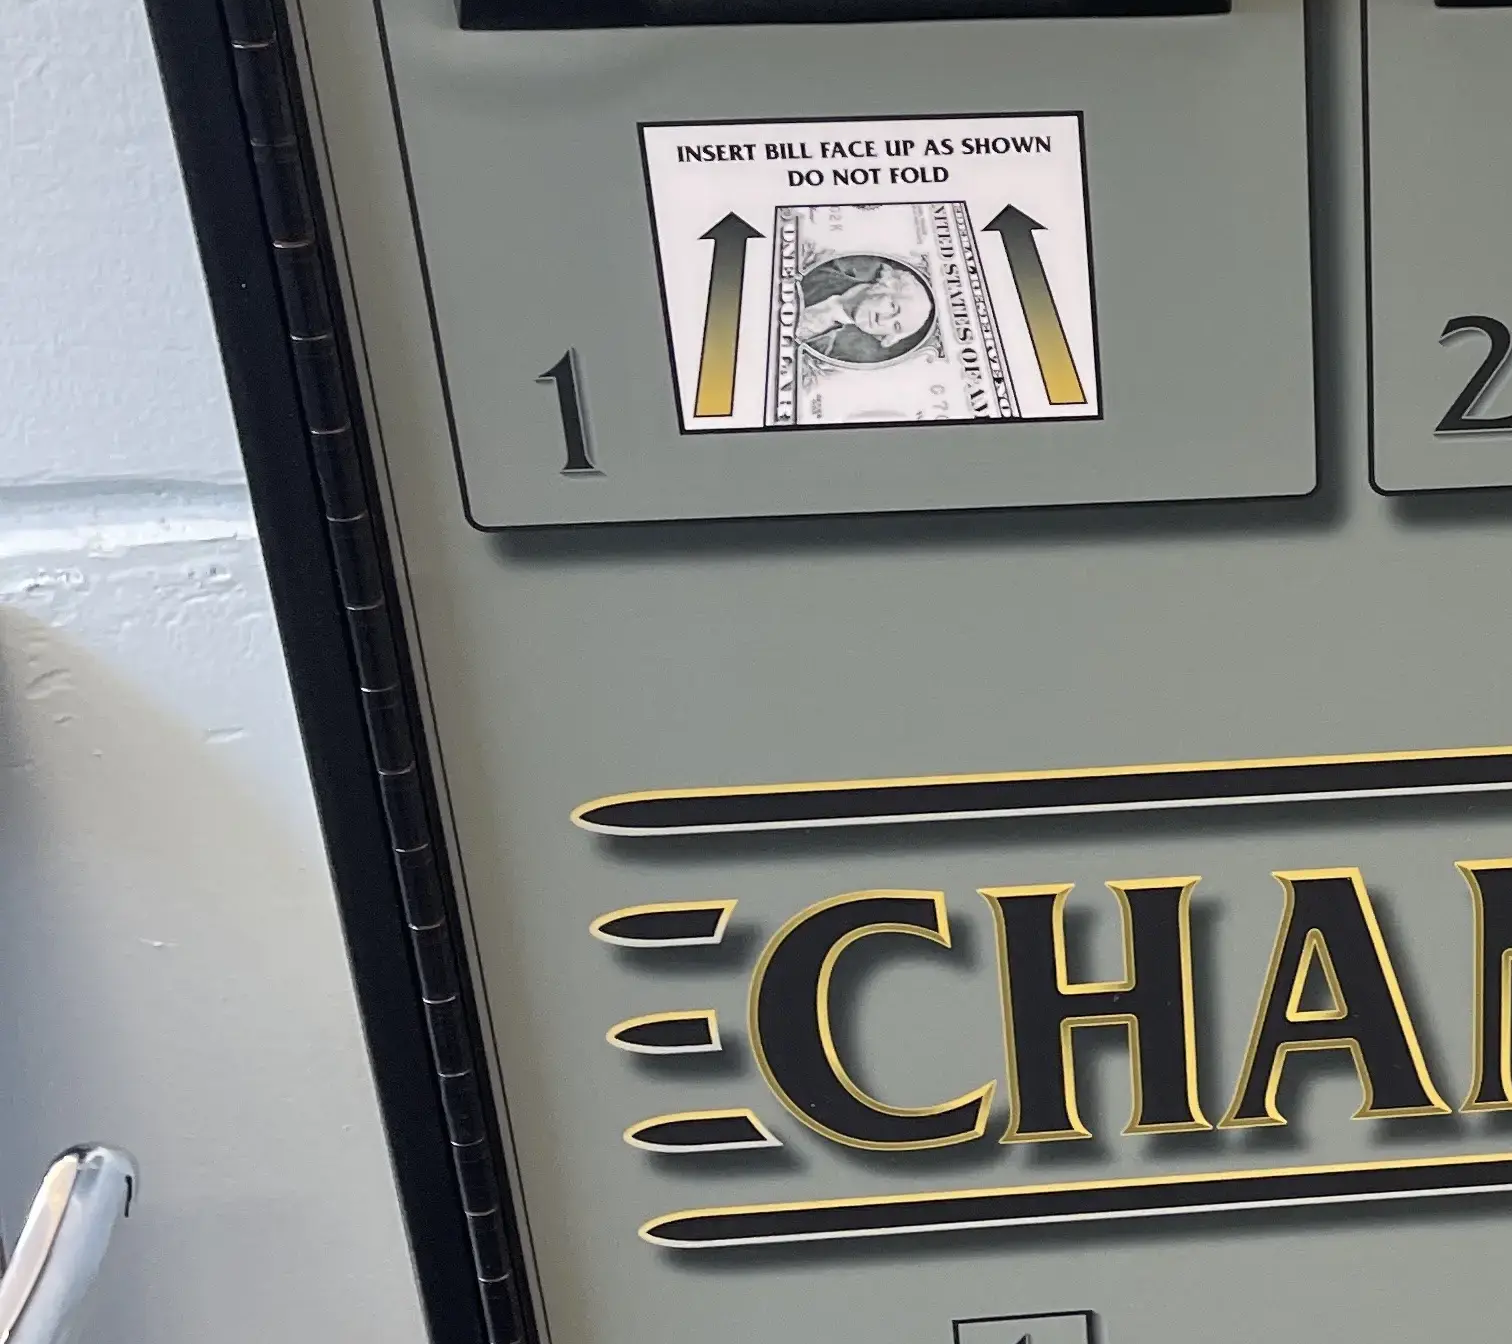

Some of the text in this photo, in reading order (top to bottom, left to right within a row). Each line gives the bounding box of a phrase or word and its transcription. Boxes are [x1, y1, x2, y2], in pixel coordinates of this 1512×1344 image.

[677, 135, 1051, 163] INSERT BILL FACE UP AS SHOWN
[787, 166, 949, 187] DO NOT FOLD
[778, 223, 797, 421] ONE DOLLAR
[944, 263, 975, 342] STATES
[961, 348, 982, 380] OF
[536, 349, 601, 474] 1
